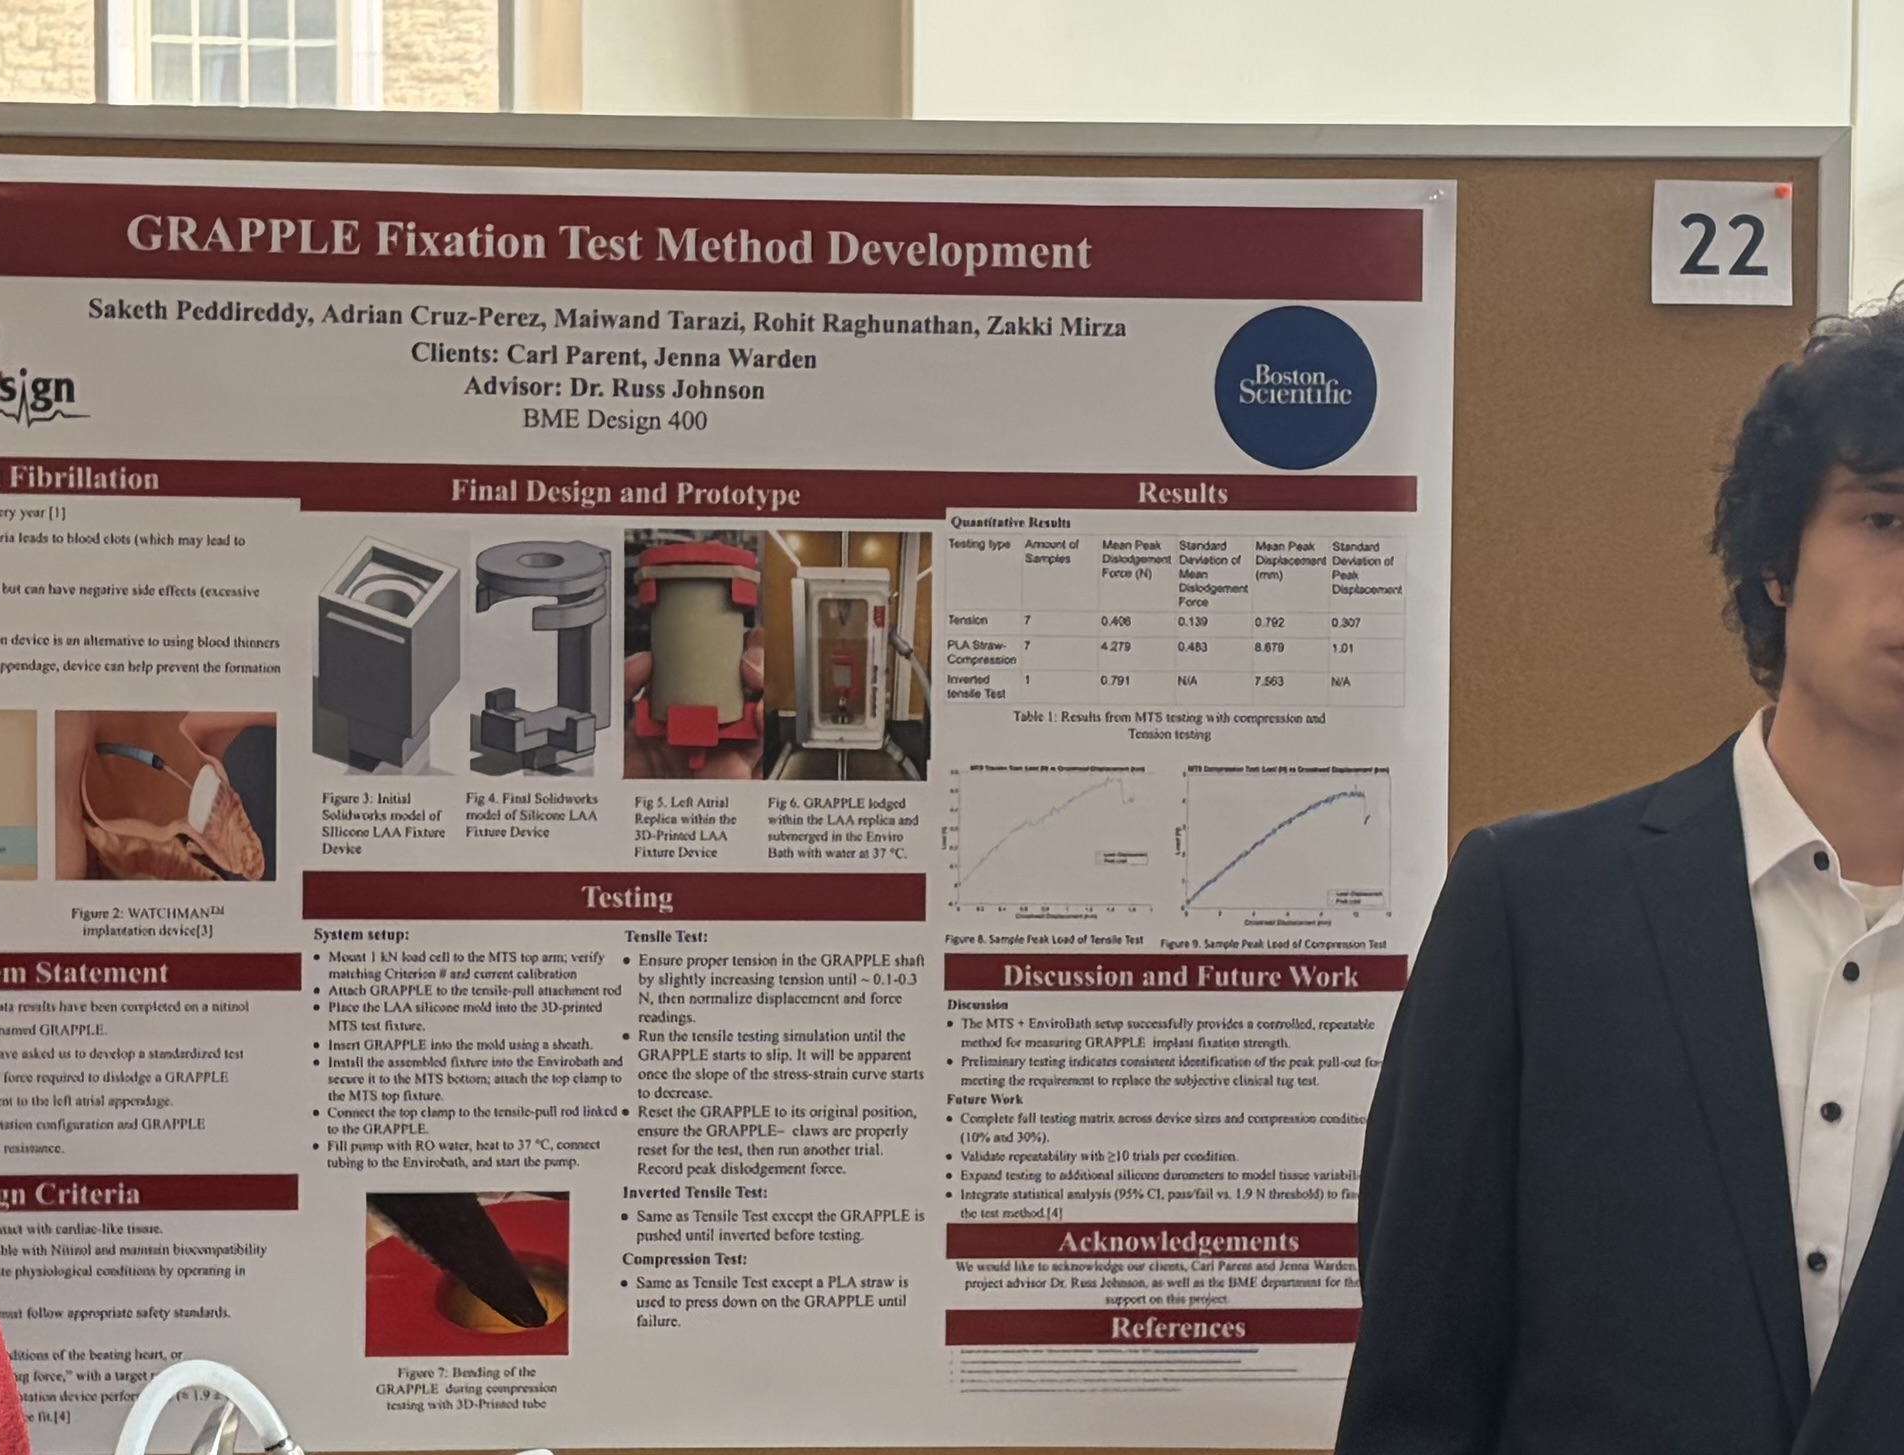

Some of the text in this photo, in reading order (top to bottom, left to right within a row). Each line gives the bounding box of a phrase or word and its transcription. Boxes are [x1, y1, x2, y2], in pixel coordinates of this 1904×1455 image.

[126, 214, 1093, 277] GRAPPLE Fixation Test Method Development
[1678, 211, 1770, 276] 22
[88, 297, 1126, 339] Saketh Peddireddy, Adrian Cruz-Perez, Maiwand Tarazi, Rohit Raghunathan, Zakki Mirza
[410, 341, 817, 370] Clients: Carl Parent, Jenna Warden
[1254, 363, 1327, 387] Boston
[463, 375, 765, 400] Advisor: Dr. Russ Johnson
[1238, 376, 1353, 409] Scientific
[522, 408, 708, 436] BME Design 400
[8, 465, 160, 492] Fibrillation
[451, 478, 801, 512] Final Design and Prototype
[1137, 481, 1230, 507] Results
[950, 515, 1071, 530] Quantitative Results
[1012, 710, 1044, 723] Table
[1060, 710, 1102, 723] Results
[1104, 710, 1132, 724] from
[1134, 711, 1164, 724] MTS
[1165, 713, 1204, 726] testing
[1205, 711, 1231, 724] with
[1232, 712, 1304, 728] compression
[1305, 712, 1326, 725] and
[581, 885, 674, 914] Testing
[313, 927, 410, 944] System setup:
[624, 929, 708, 944] Tensile Test:
[34, 961, 170, 985] Statement
[638, 952, 925, 970] Ensure proper tension in the GRAPPLE shaft
[638, 972, 655, 989] by
[658, 972, 707, 989] slightly
[710, 971, 775, 989] increasing
[778, 972, 825, 986] tension
[828, 972, 857, 986] until
[1002, 964, 1361, 989] Discussion and Future Work
[947, 998, 1009, 1011] Discussion
[946, 1093, 1024, 1106] Future Work
[34, 1181, 141, 1206] Criteria
[623, 1185, 768, 1199] Inverted Tensile Test:
[636, 1208, 926, 1226] Same as Tensile Test except the GRAPPLE is
[1058, 1231, 1300, 1257] Acknowledgements
[622, 1252, 748, 1269] Compression Test:
[1111, 1316, 1246, 1339] References
